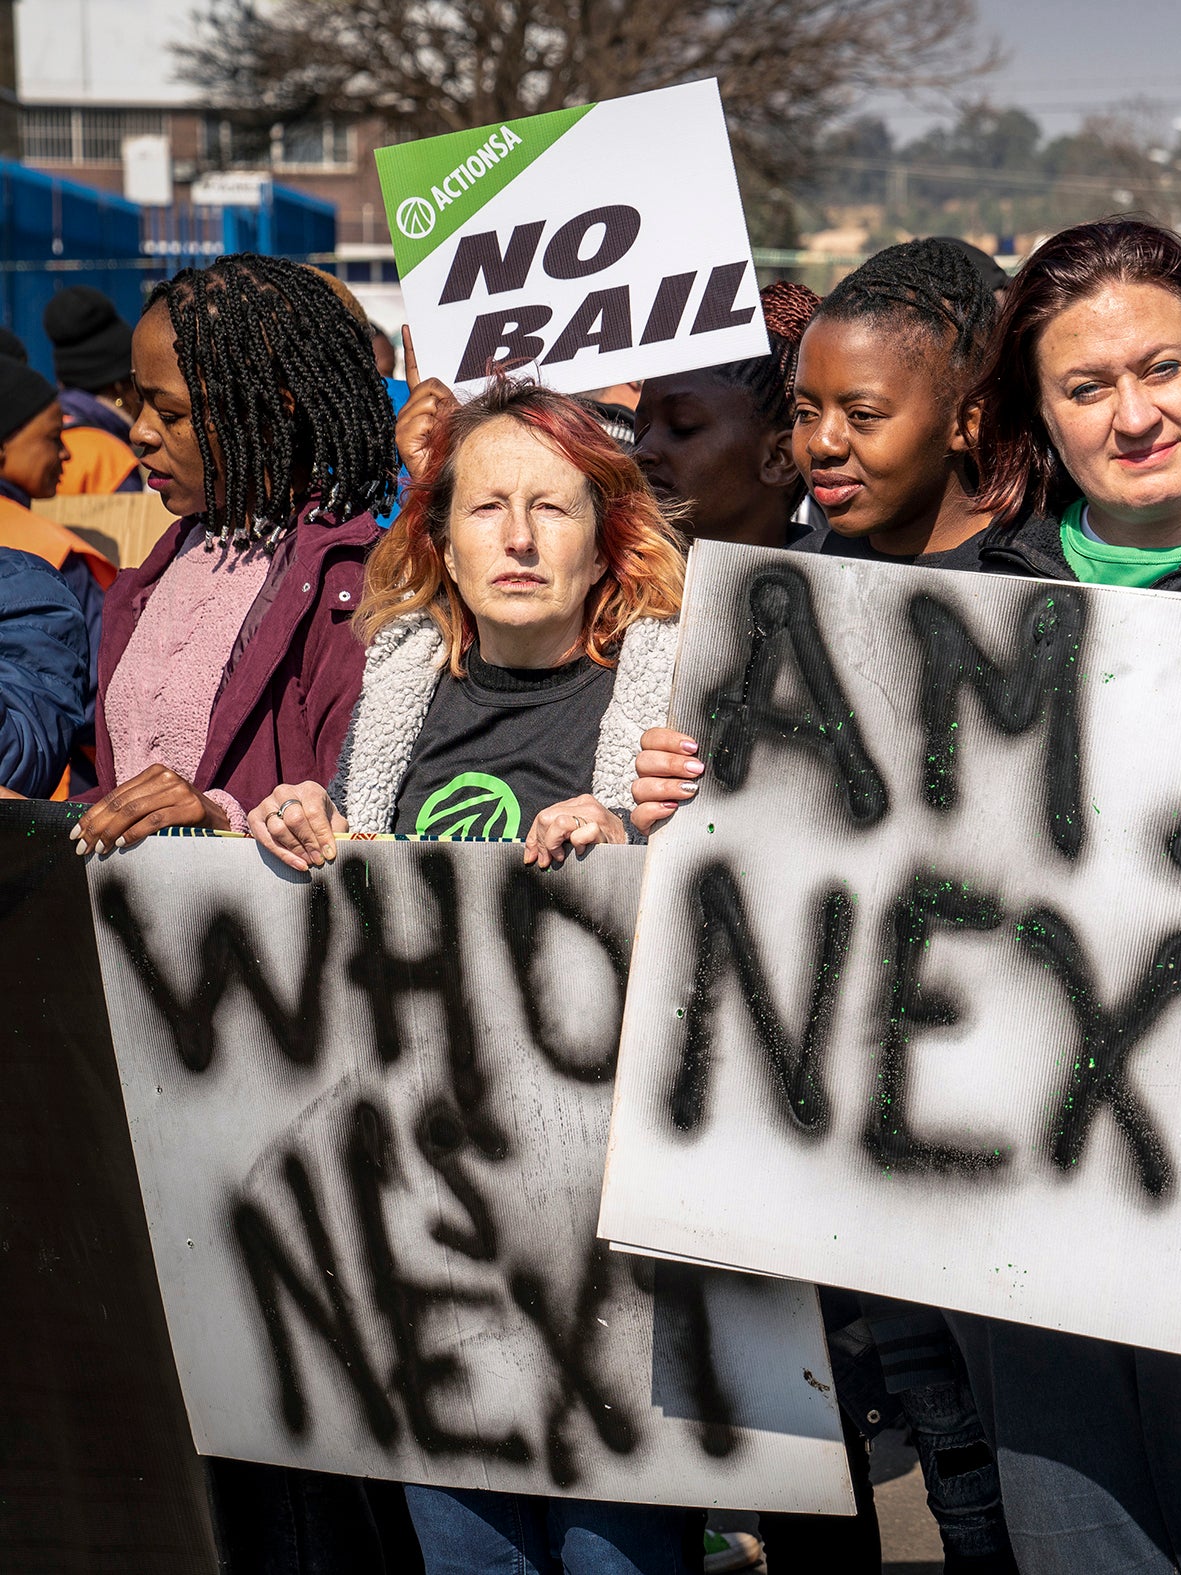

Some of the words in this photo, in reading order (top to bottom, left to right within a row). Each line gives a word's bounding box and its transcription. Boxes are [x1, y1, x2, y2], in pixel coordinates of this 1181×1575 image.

[430, 126, 522, 211] ACTIONSA
[438, 204, 641, 305] NO
[454, 260, 756, 384] BAIL
[704, 564, 1088, 860] AM
[98, 850, 628, 1106] WHO
[232, 1150, 770, 1486] NEXT
